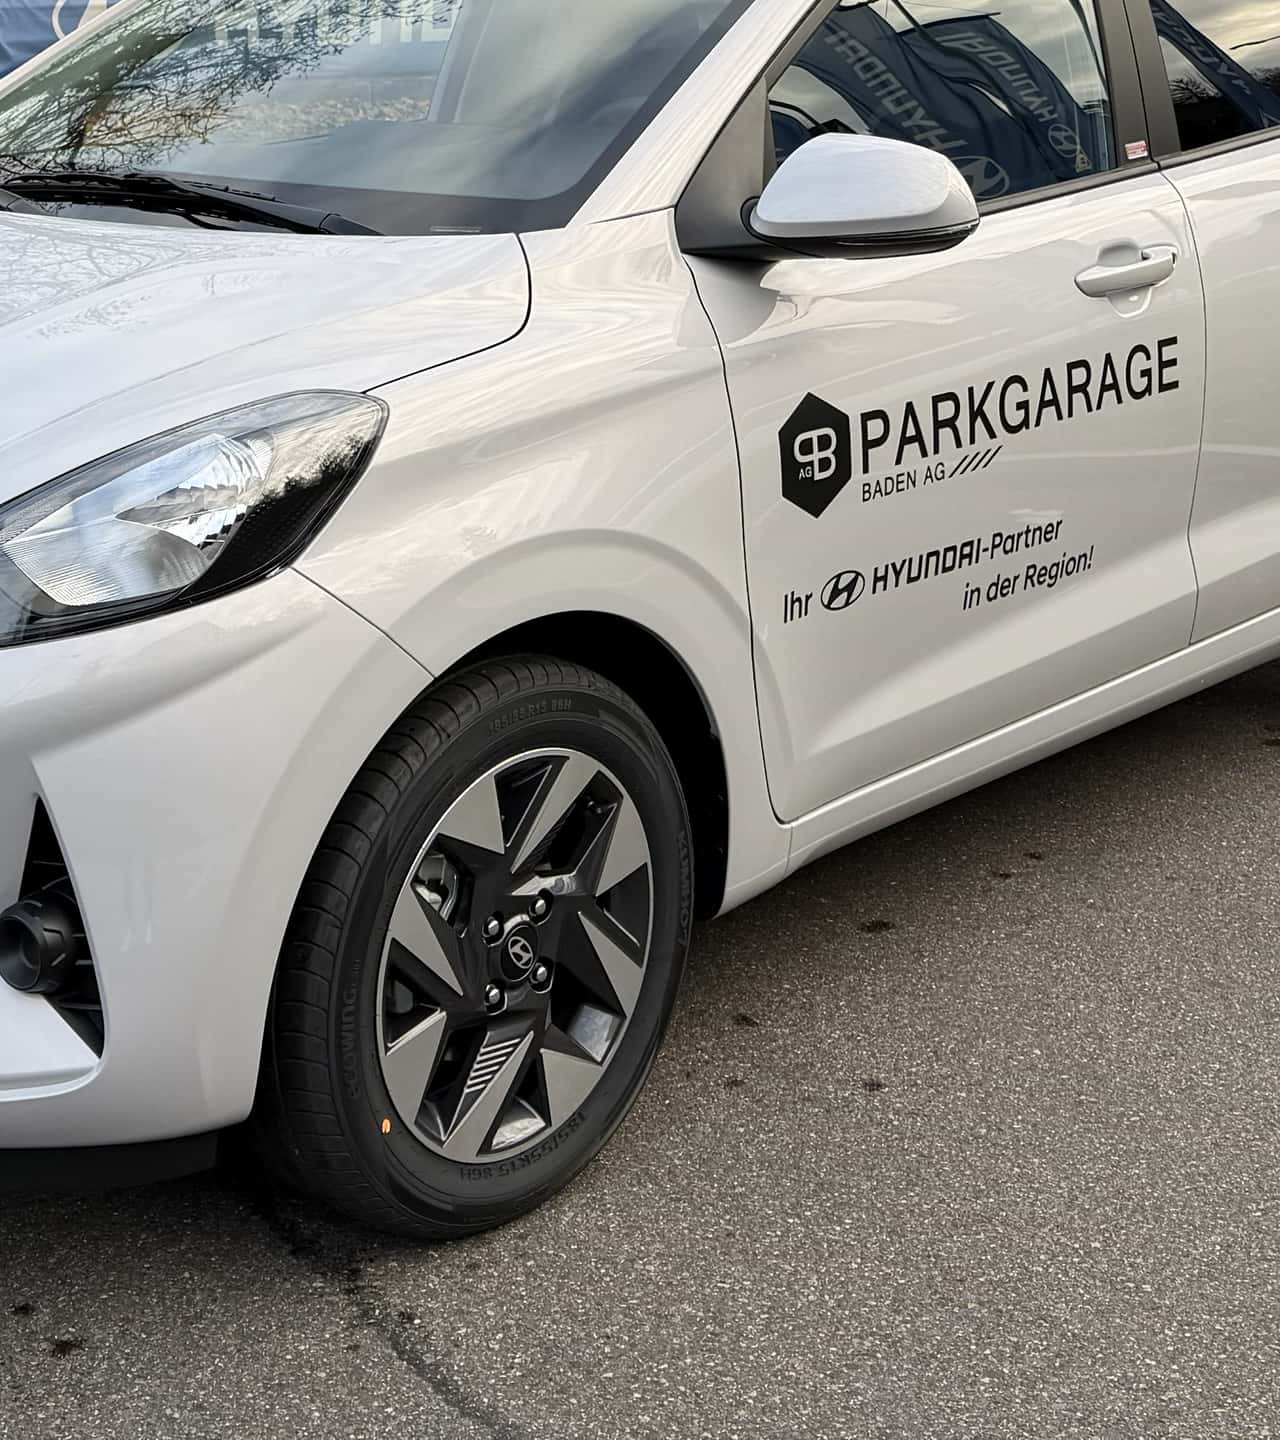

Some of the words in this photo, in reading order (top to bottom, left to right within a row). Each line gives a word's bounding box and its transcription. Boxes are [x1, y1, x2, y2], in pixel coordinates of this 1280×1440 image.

[860, 336, 1180, 474] PARKGARAGE
[862, 470, 917, 503] BADEN
[923, 462, 946, 486] AG
[783, 591, 813, 624] Ihr
[872, 519, 1063, 595] HYUNDAI-Partner
[963, 582, 981, 610] in
[986, 573, 1020, 605] der
[1023, 545, 1095, 591] Region!
